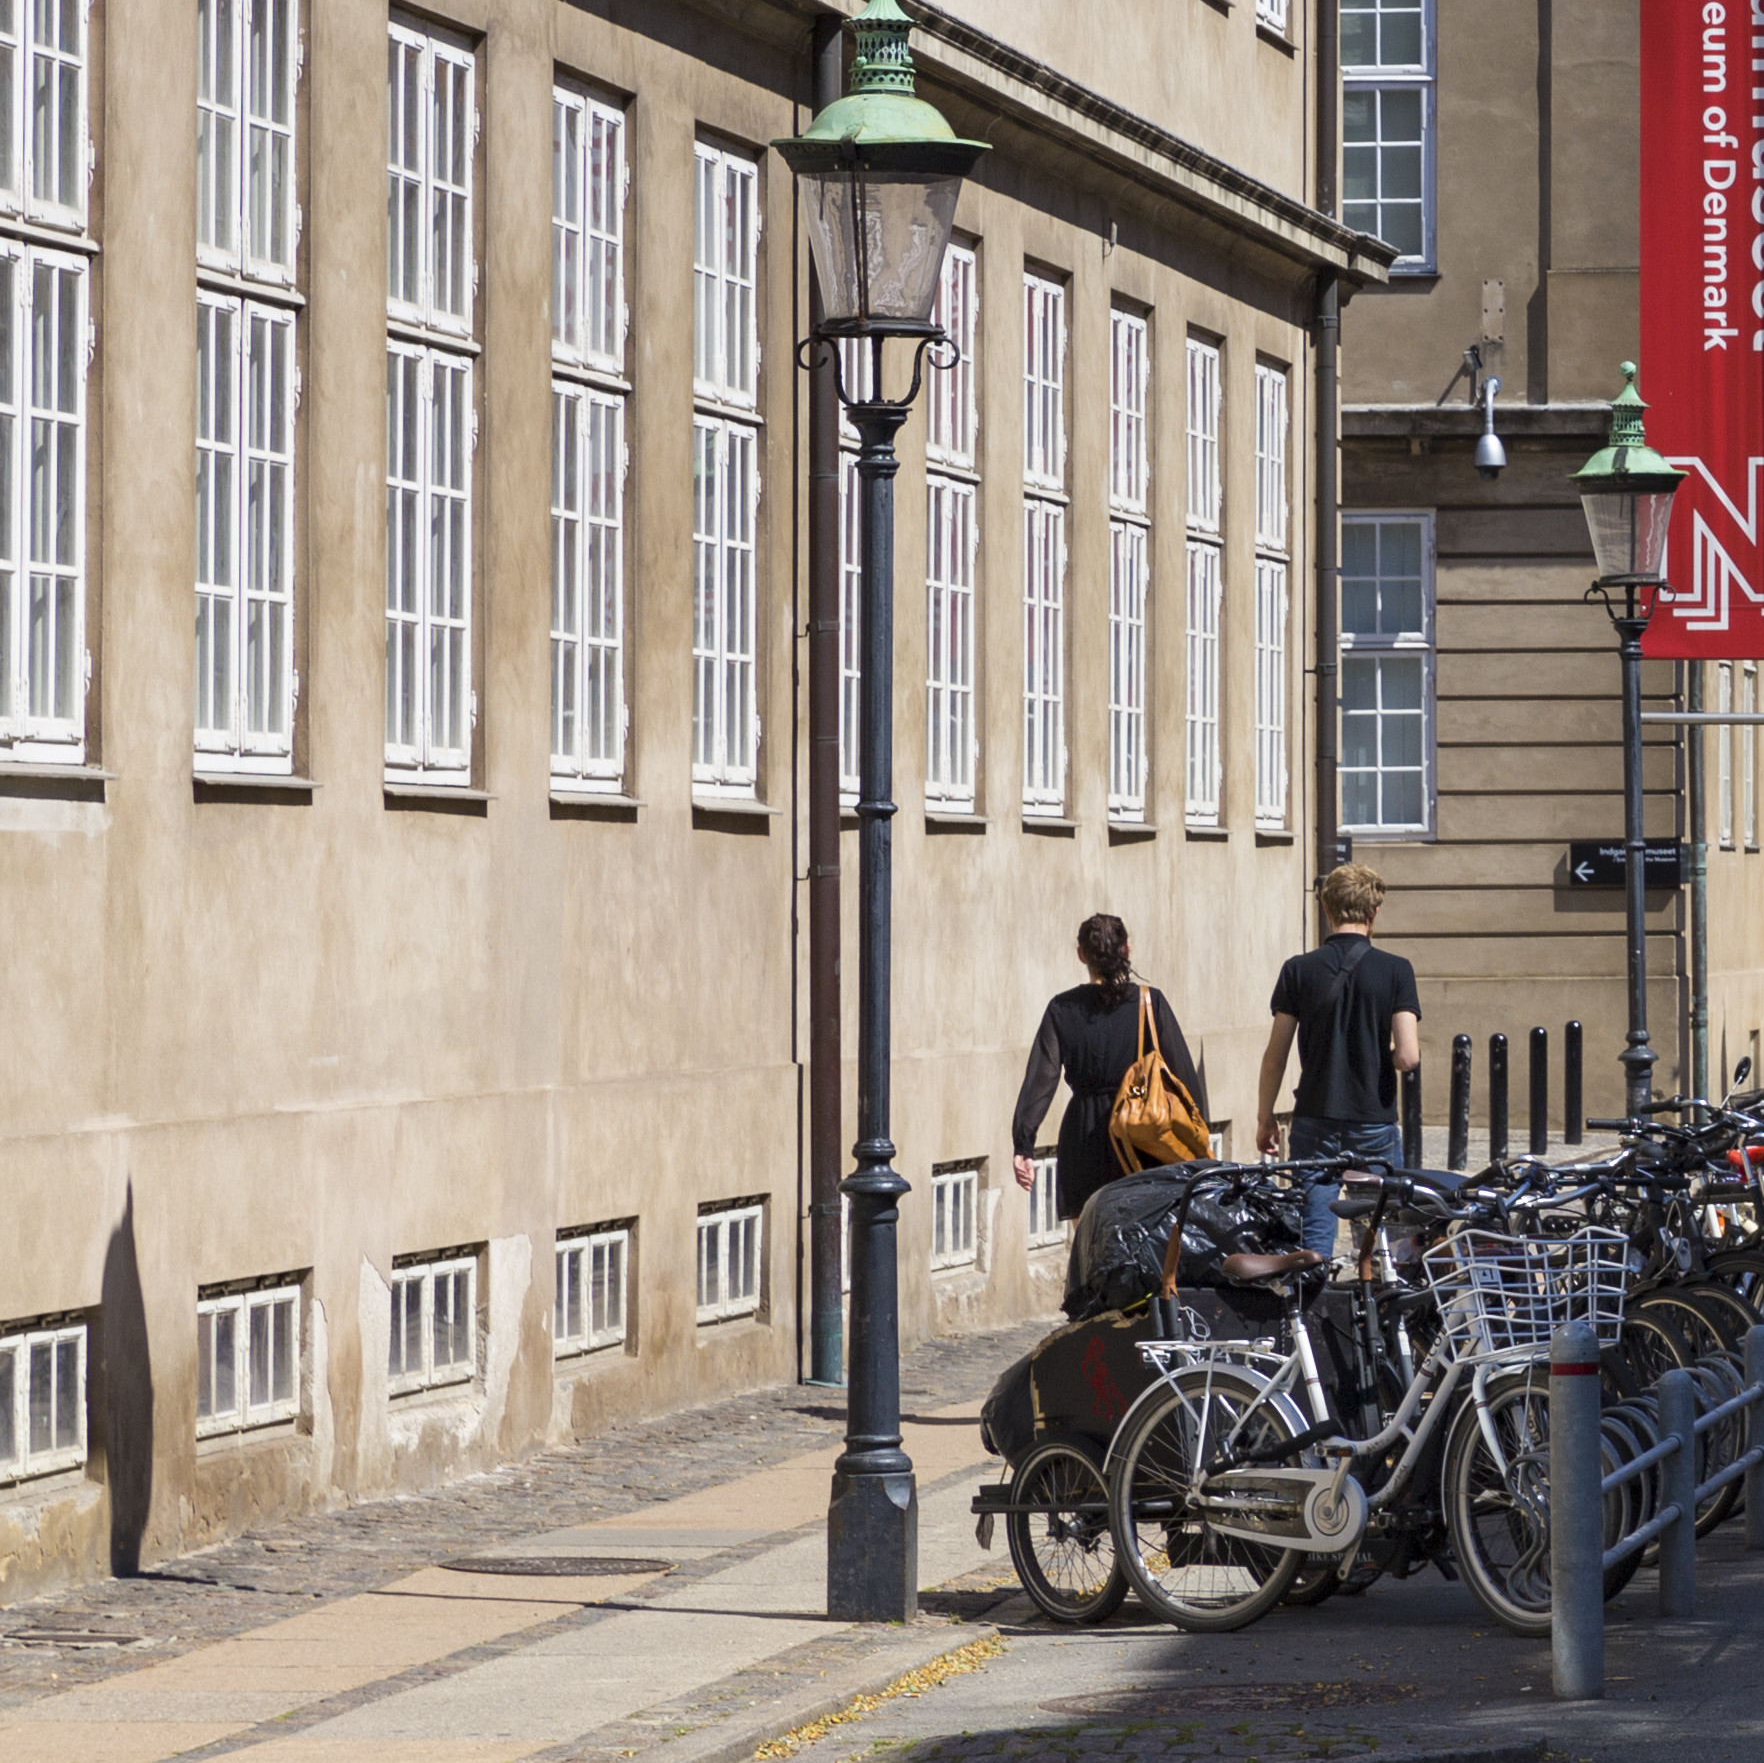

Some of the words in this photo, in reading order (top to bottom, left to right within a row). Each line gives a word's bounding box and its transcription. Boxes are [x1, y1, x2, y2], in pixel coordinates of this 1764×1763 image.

[1702, 105, 1739, 149] of
[1702, 159, 1739, 351] Denmark
[1331, 1552, 1374, 1562] SPIAL
